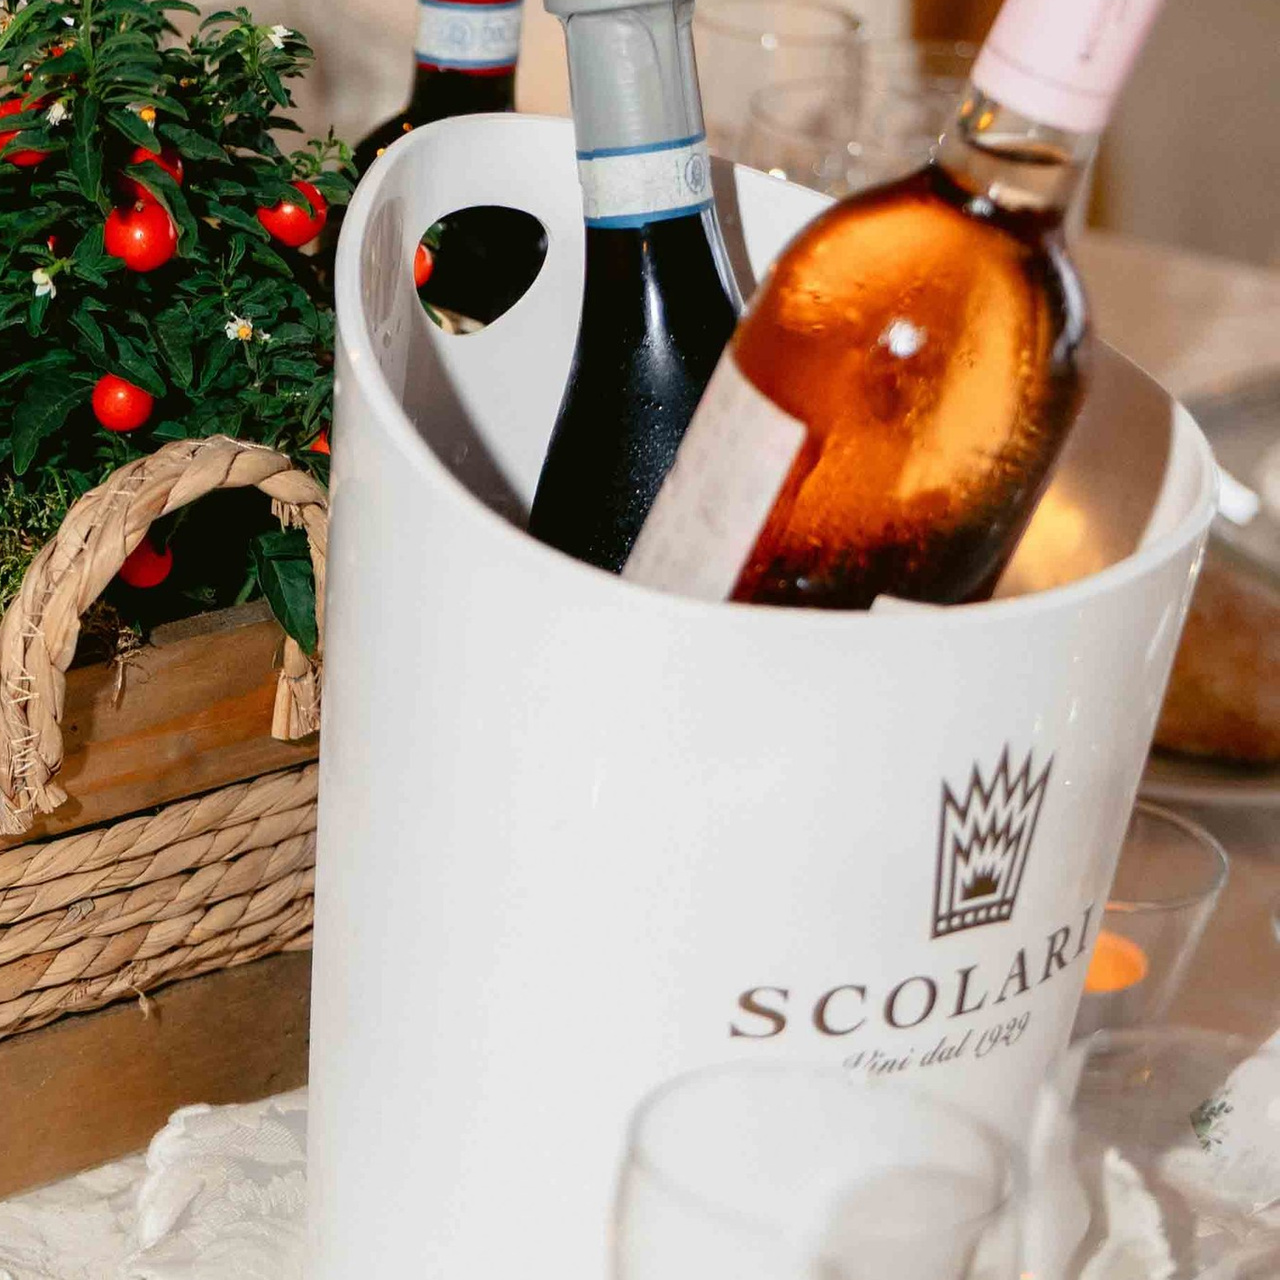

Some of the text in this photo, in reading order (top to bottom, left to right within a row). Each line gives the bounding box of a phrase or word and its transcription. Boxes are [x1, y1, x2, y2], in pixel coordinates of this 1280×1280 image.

[729, 902, 1095, 1039] SCOLARI
[842, 1010, 1032, 1077] Vini dal 1929
